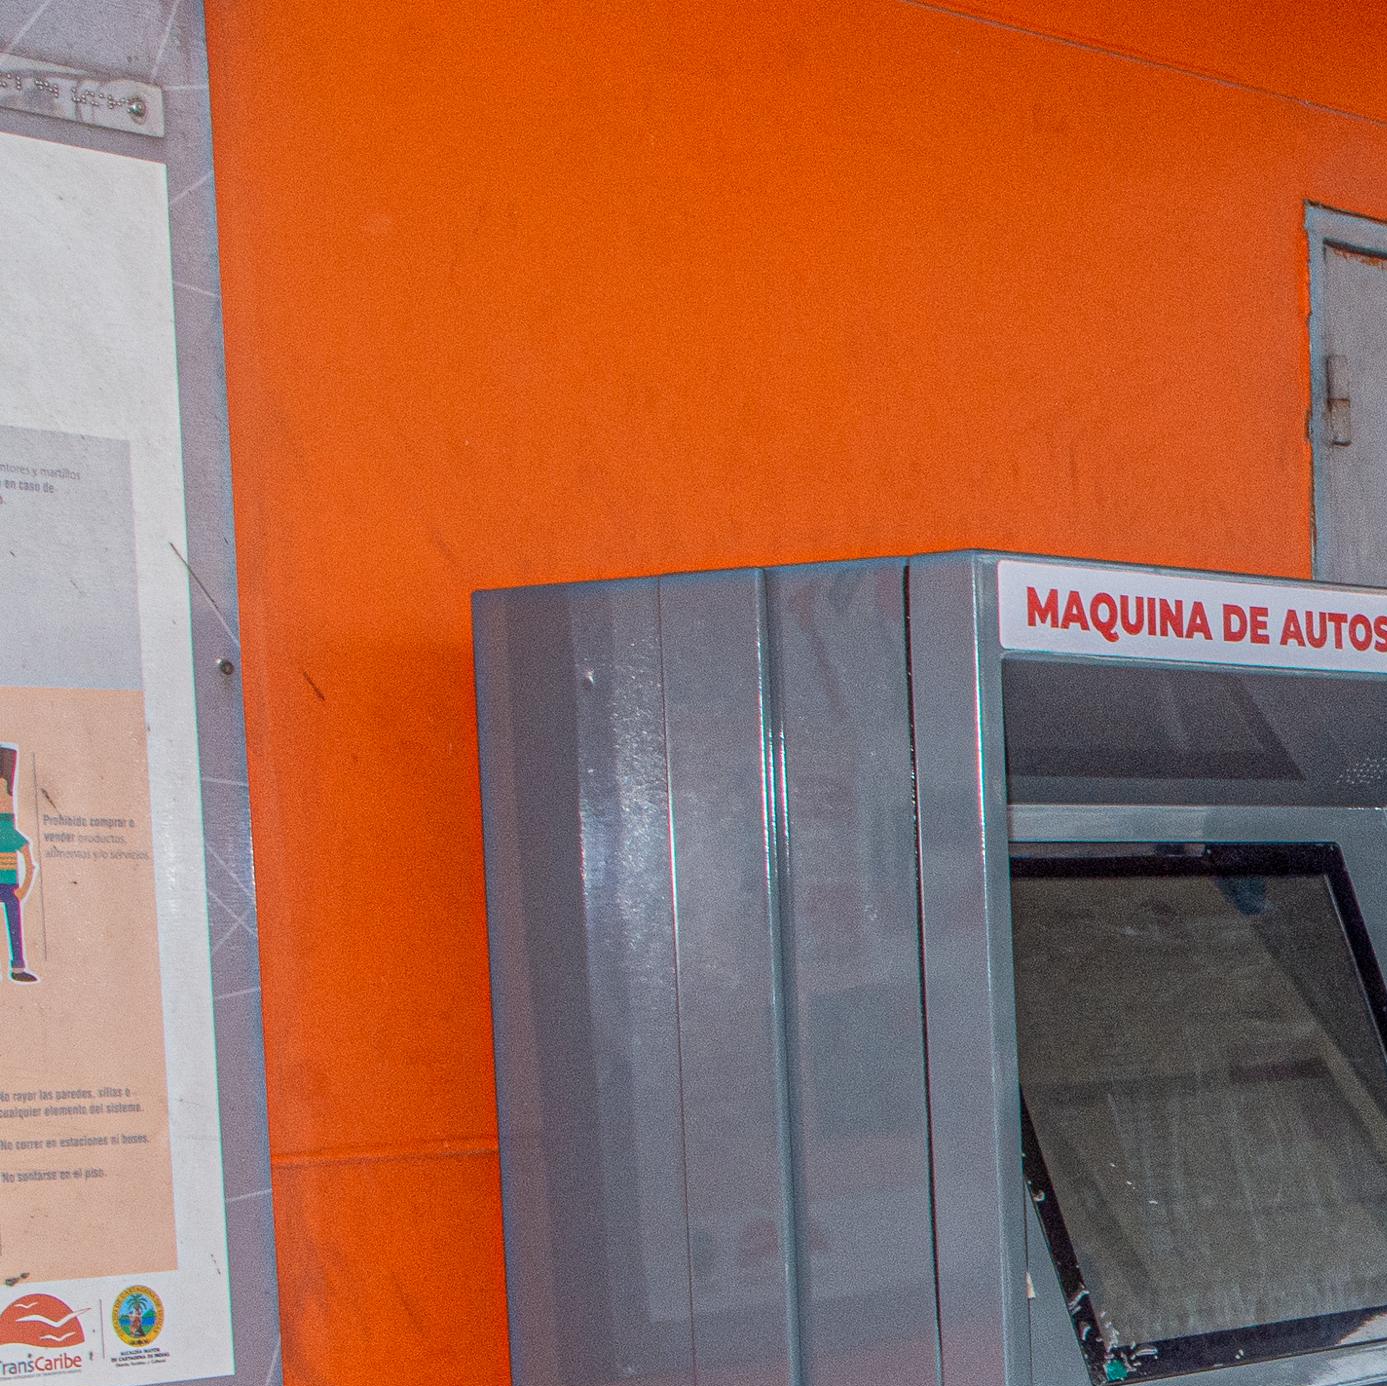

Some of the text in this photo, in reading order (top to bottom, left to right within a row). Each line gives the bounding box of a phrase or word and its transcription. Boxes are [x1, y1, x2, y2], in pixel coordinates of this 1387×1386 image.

[1026, 586, 1213, 642] MAQUINA
[1223, 604, 1270, 645] DE
[0, 1352, 82, 1376] ransCaribe
